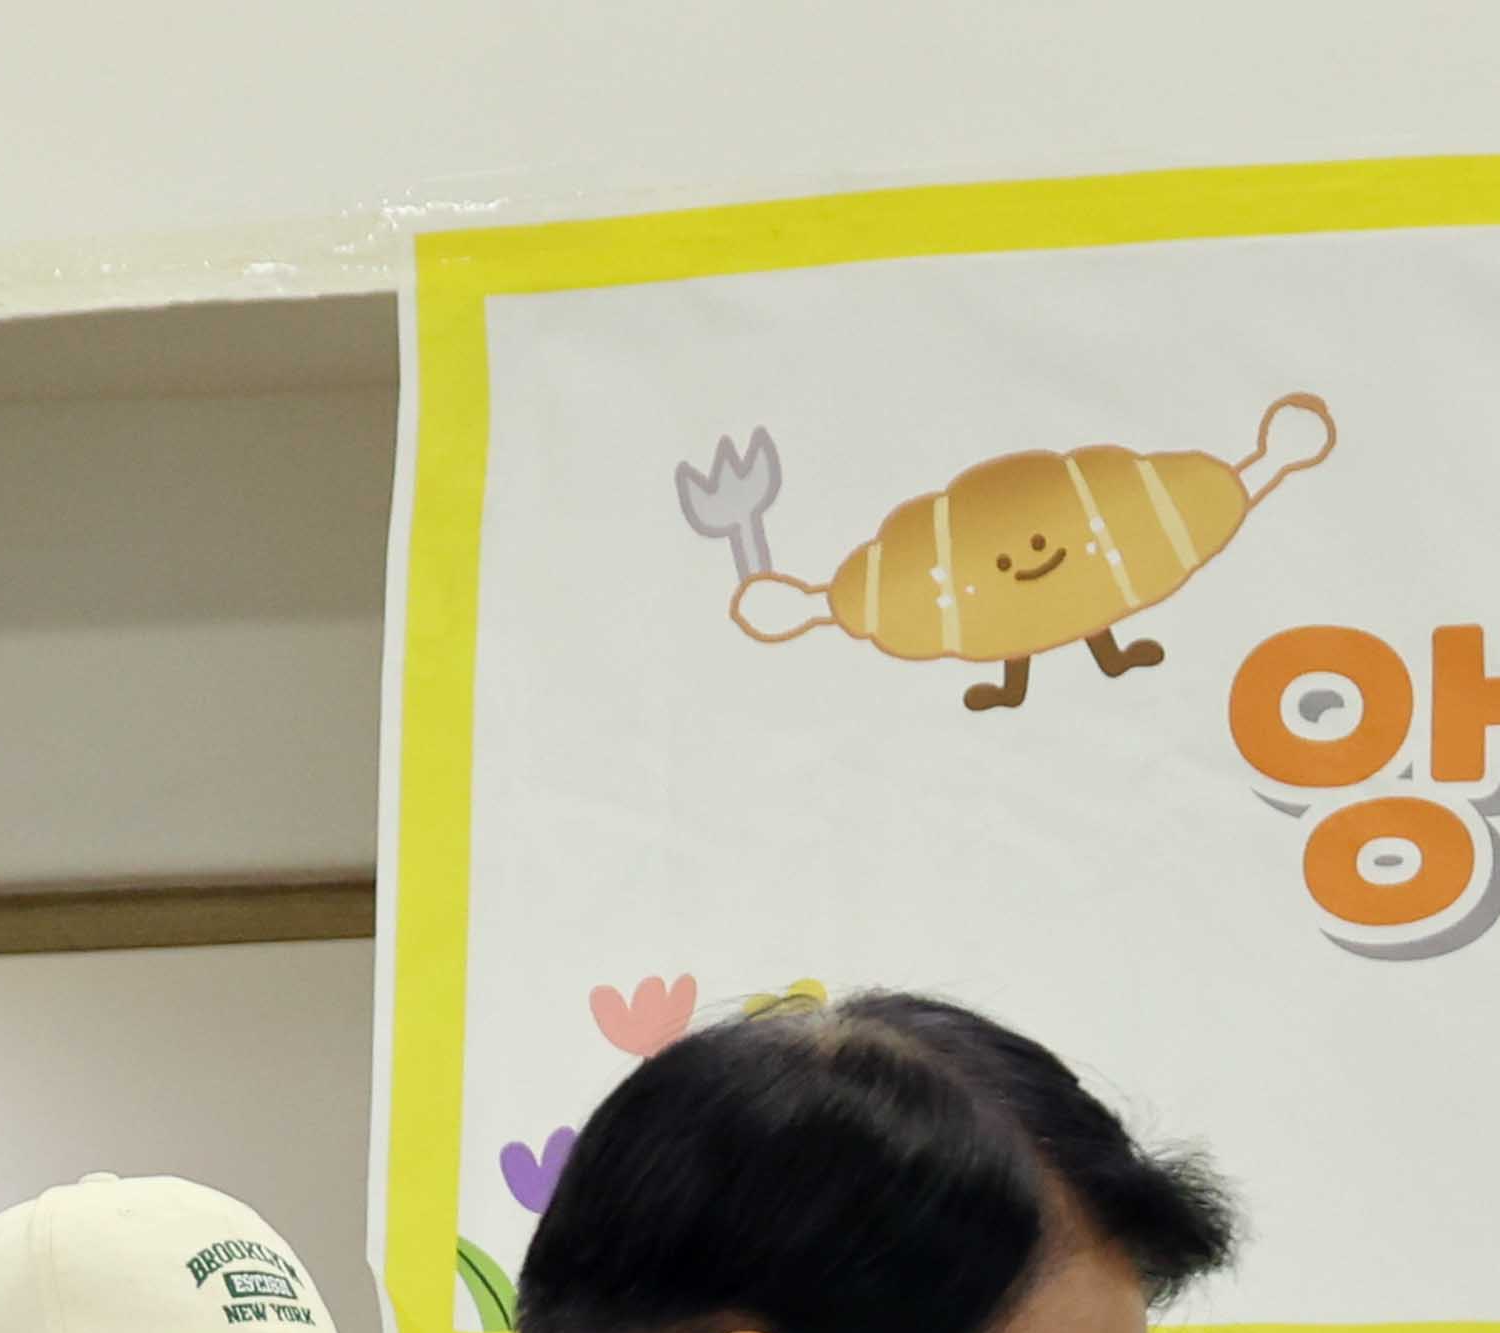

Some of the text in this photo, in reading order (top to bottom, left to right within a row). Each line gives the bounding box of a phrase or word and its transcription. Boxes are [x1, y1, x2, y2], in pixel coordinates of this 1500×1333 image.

[186, 1239, 305, 1288] BROOKLYN
[222, 1302, 316, 1326] NEW YORK
